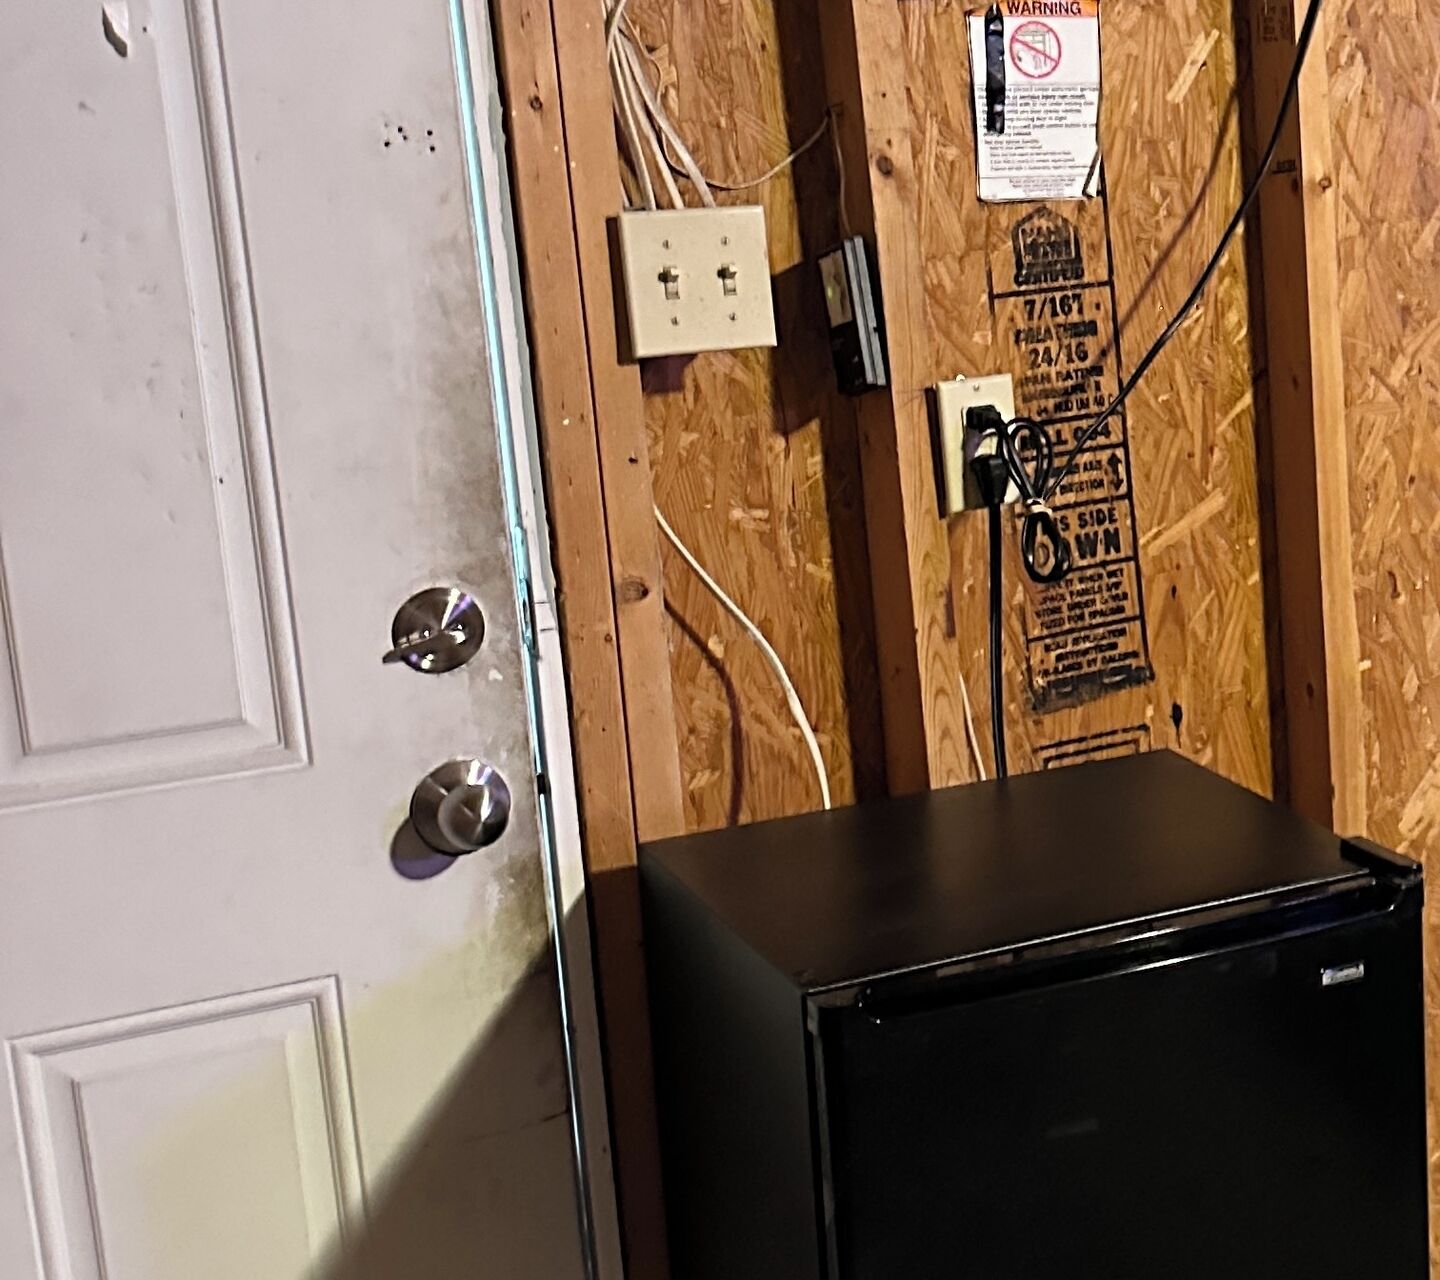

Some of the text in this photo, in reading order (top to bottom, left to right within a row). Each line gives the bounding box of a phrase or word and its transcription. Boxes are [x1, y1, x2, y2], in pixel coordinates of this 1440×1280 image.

[1006, 0, 1081, 16] WARNING
[1029, 342, 1088, 369] 24/16
[1078, 507, 1118, 529] SIDE
